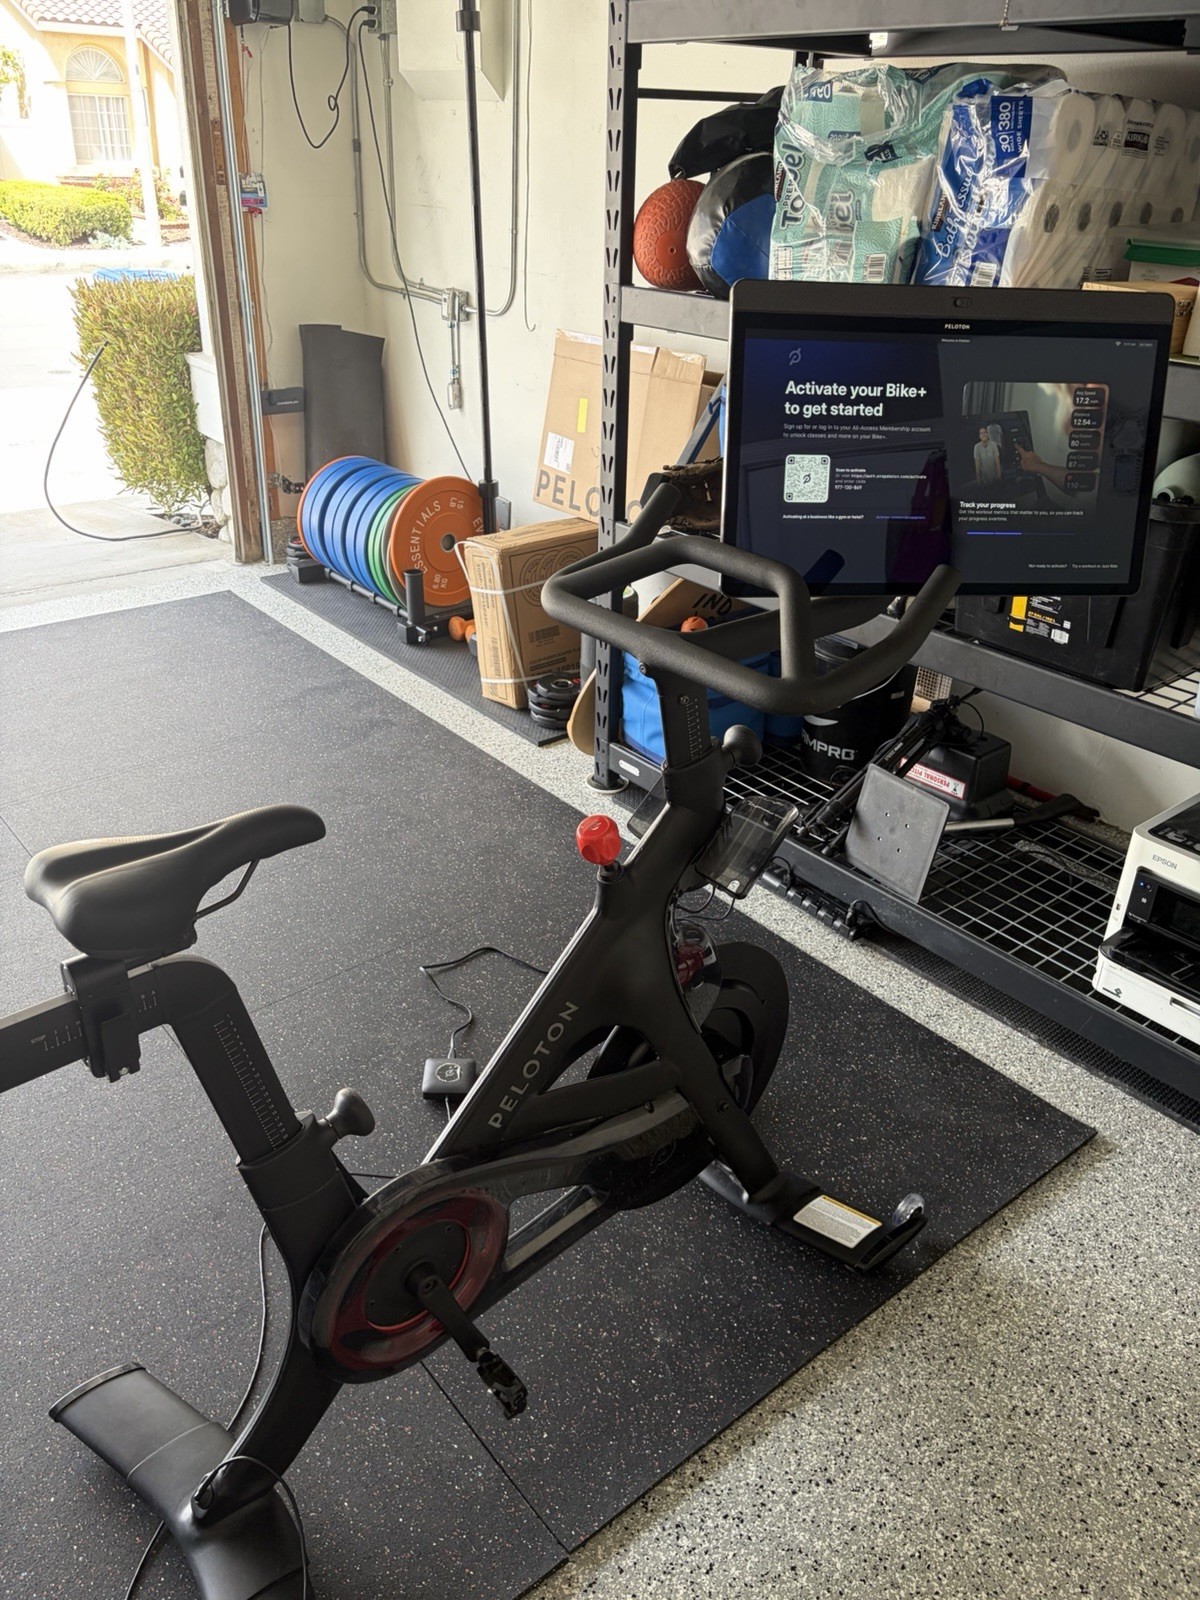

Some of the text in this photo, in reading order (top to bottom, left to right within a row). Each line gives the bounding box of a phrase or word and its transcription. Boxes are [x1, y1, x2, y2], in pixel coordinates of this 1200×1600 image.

[998, 102, 1011, 152] 30 380
[931, 193, 947, 230] KIRKLAN
[935, 216, 961, 259] Bath
[784, 380, 927, 400] Activate your Bike+
[784, 402, 884, 418] to get started
[783, 423, 796, 431] Sign
[449, 497, 458, 509] LB
[976, 502, 990, 510] your
[990, 502, 1016, 510] progress
[440, 578, 448, 590] KG
[1152, 854, 1178, 870] EPSON
[488, 1001, 580, 1129] PELOTON
